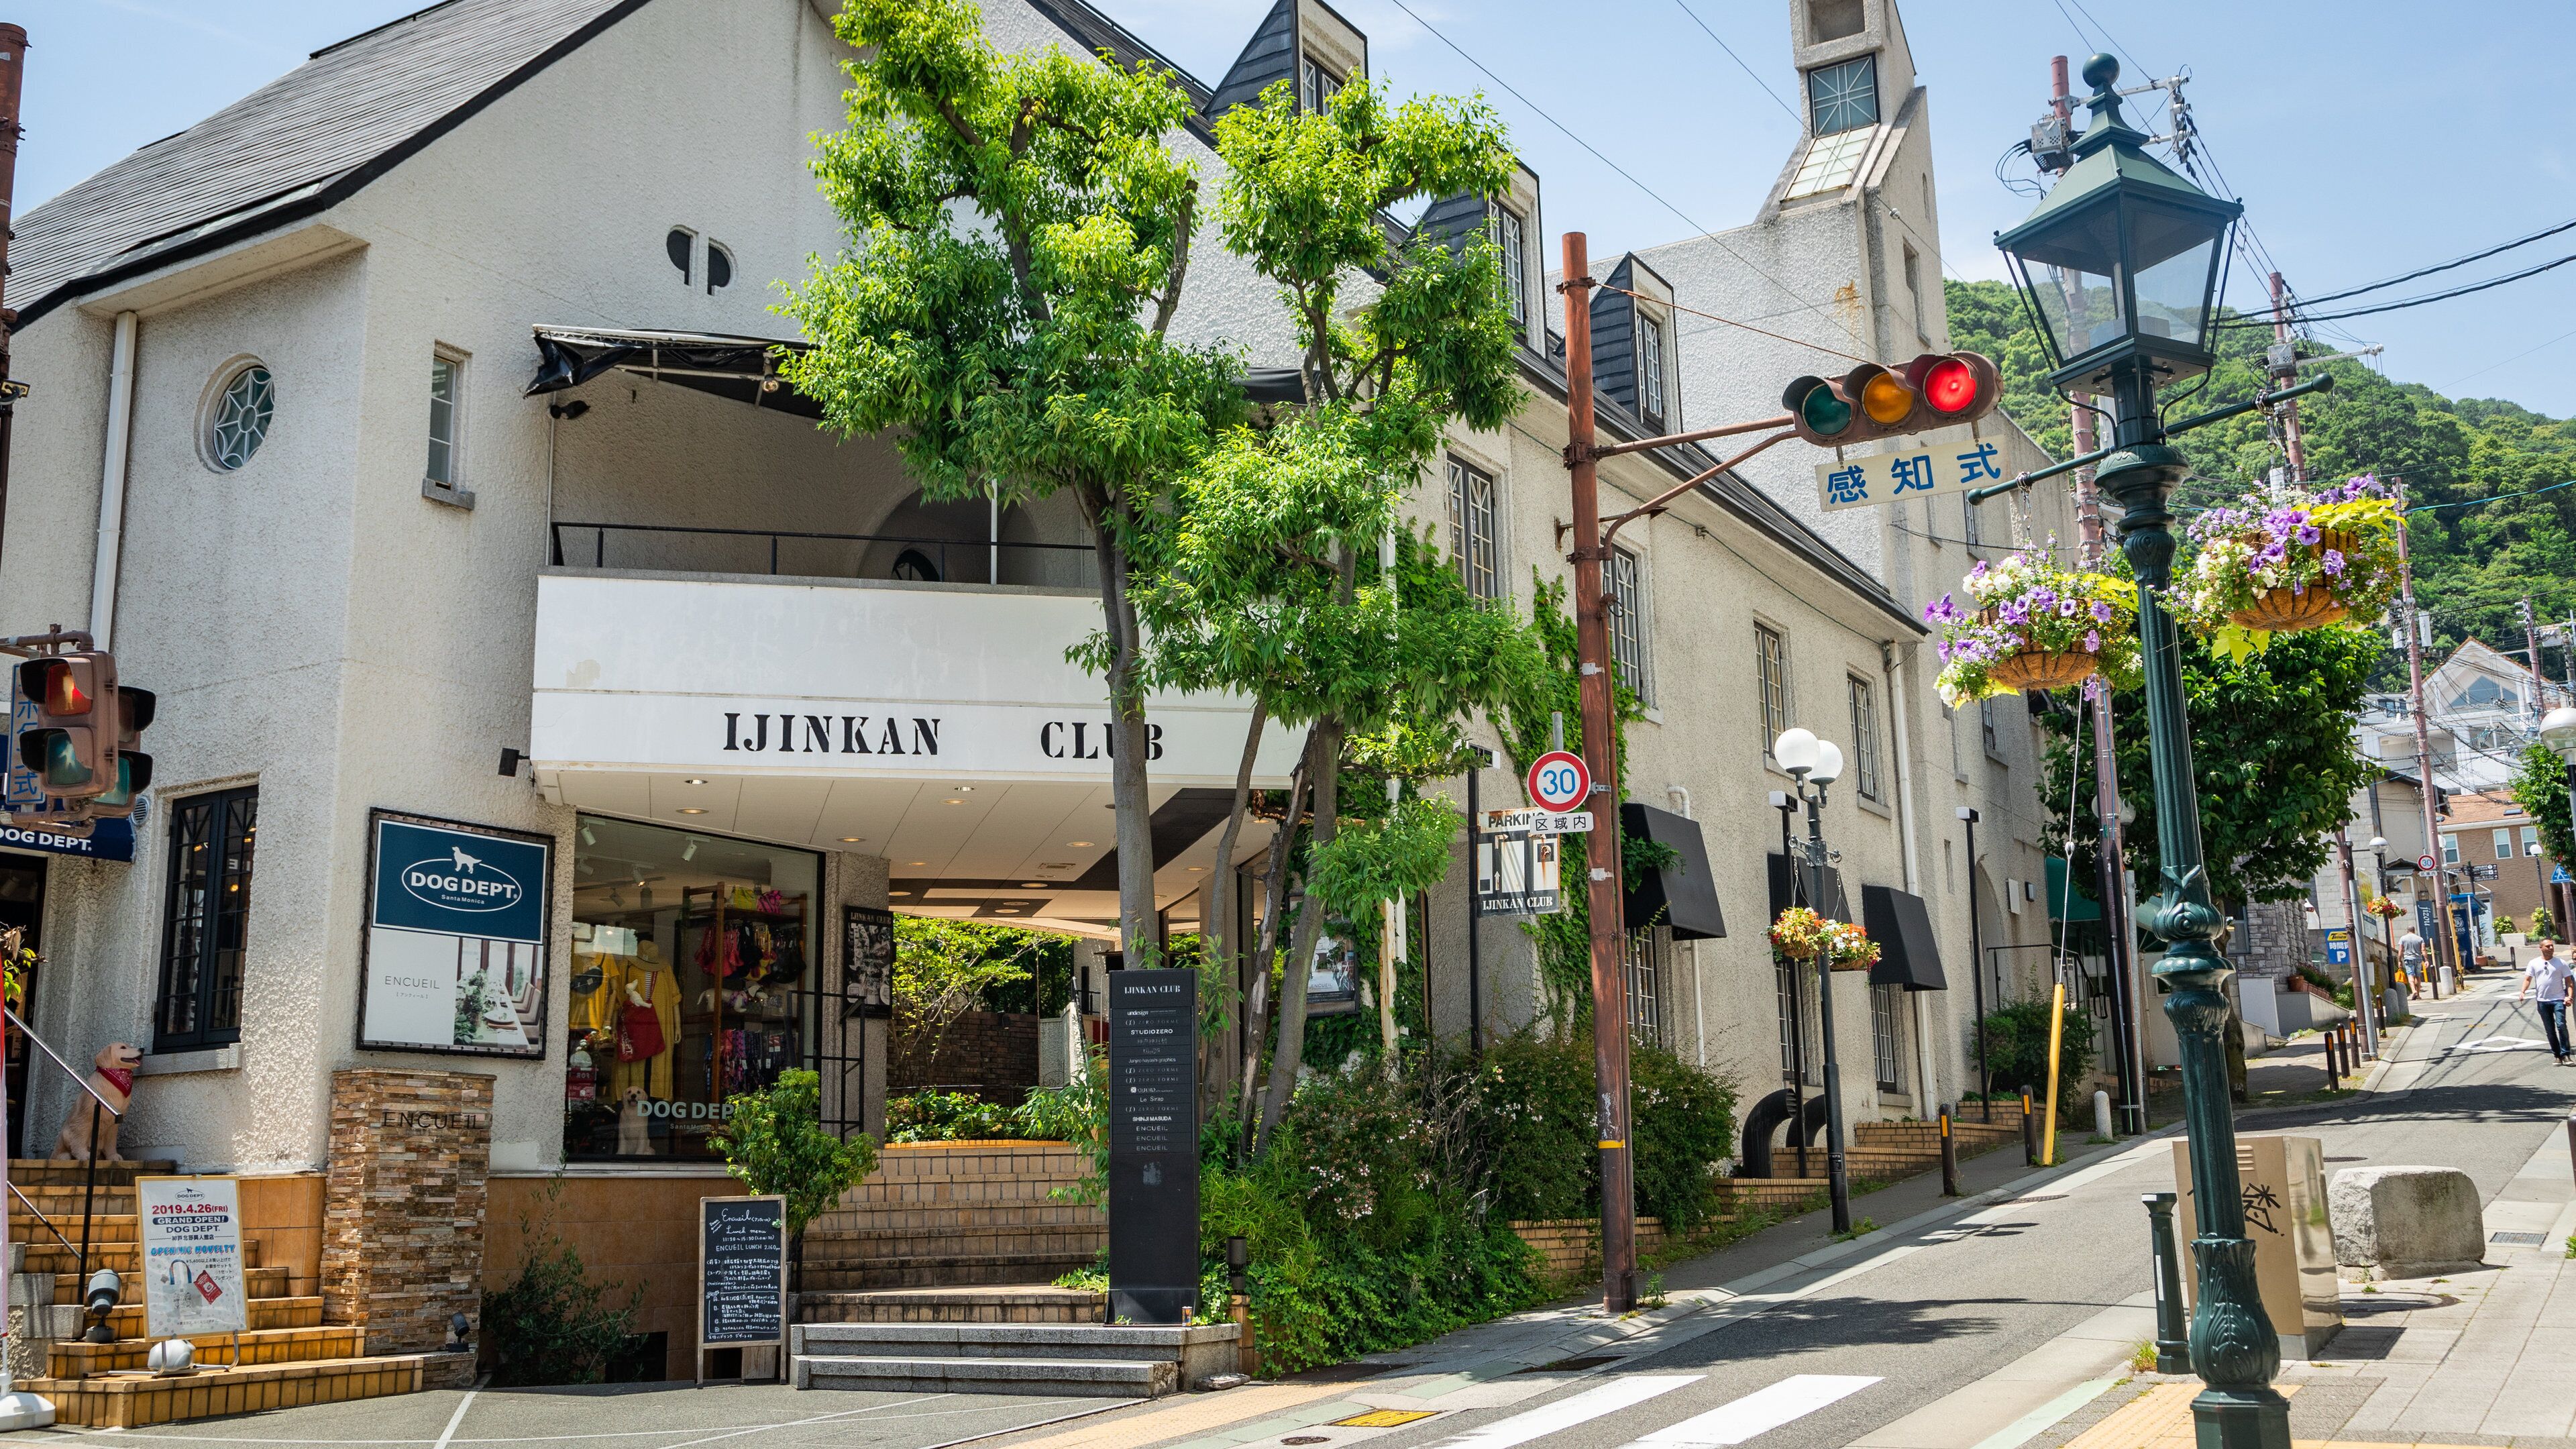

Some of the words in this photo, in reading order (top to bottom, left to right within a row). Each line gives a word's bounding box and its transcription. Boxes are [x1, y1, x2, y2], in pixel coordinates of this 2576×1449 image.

[1827, 443, 2001, 504] 感知式
[723, 712, 941, 755] IJINKAN
[1543, 768, 1575, 796] 30
[1489, 812, 1544, 828] PARKIN
[1536, 816, 1587, 831] 区域内
[2421, 859, 2432, 867] 30
[411, 871, 459, 892] DOG
[1483, 898, 1524, 910] IJINKAN
[1527, 896, 1553, 908] CLUB
[851, 912, 875, 922] IJINKAN
[876, 915, 892, 924] CLUB
[2418, 904, 2431, 926] jizou
[2337, 951, 2347, 962] P
[384, 975, 441, 989] ENCUEIL
[1125, 986, 1157, 994] IJINKAN
[637, 1100, 687, 1118] DOG
[692, 1102, 734, 1120] DEP
[382, 1112, 484, 1129] ENCUEIL
[722, 1208, 751, 1222] Encueil
[726, 1225, 746, 1234] Lunch
[150, 1246, 193, 1256] OPENING
[195, 1244, 235, 1254] NOVELTY
